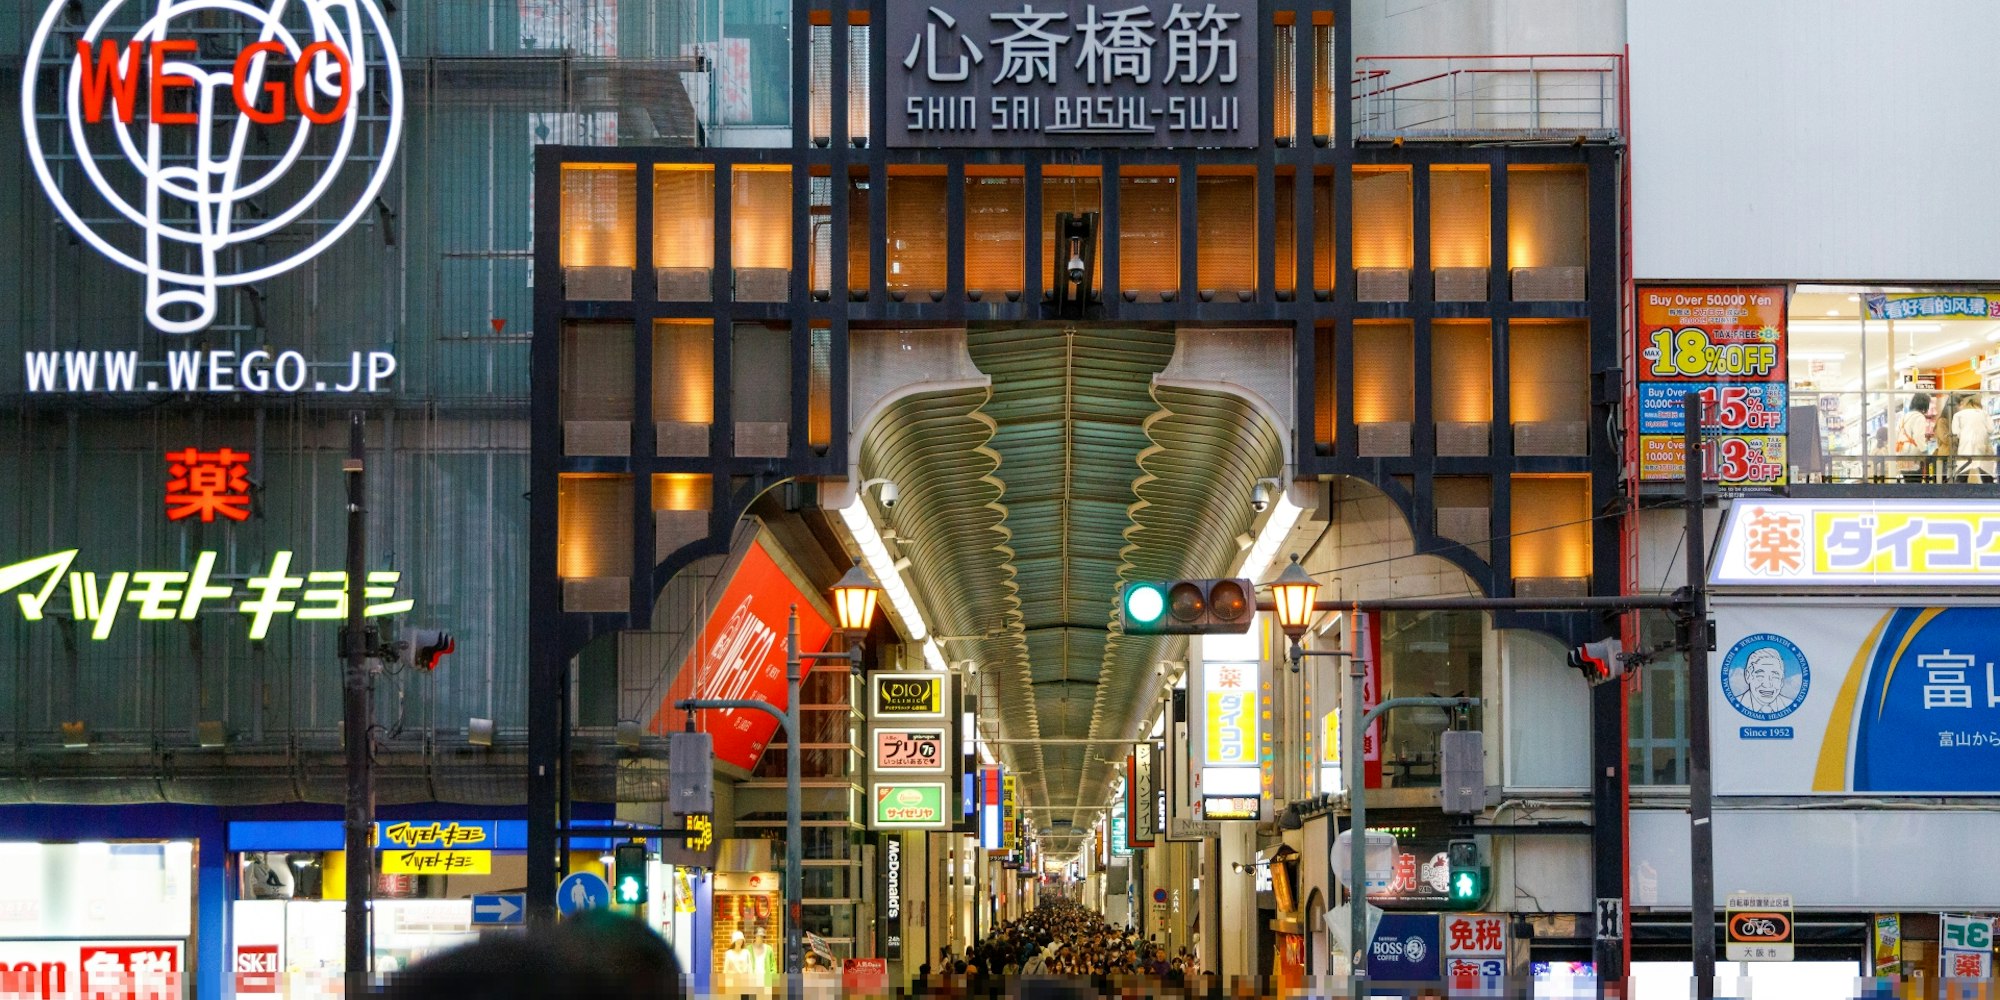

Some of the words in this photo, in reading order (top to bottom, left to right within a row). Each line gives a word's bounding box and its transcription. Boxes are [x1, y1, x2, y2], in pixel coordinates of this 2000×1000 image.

[903, 4, 1240, 84] 心斎橋筋
[907, 97, 976, 131] SHIN
[991, 97, 1040, 131] SAI
[1650, 295, 1672, 307] Buy
[1676, 295, 1703, 306] Over
[1706, 295, 1746, 307] 50,000
[1749, 295, 1772, 306] Yen
[1886, 296, 1986, 319] 看好看的风景
[25, 350, 397, 393] WWW.WEGO.JP
[1648, 388, 1664, 398] Buy
[1699, 387, 1747, 429] 15
[1748, 413, 1781, 428] OFF
[1649, 441, 1665, 451] Buy
[1645, 452, 1673, 461] 10,000
[1749, 465, 1782, 481] OFF
[165, 447, 250, 523] 薬
[1748, 507, 1801, 572] 薬
[1917, 649, 2000, 710] 富
[891, 683, 922, 697] DIO
[1220, 694, 1242, 759] ダイコク
[1744, 728, 1767, 737] Since
[1769, 728, 1790, 737] 1952
[884, 740, 918, 758] プリ
[922, 745, 934, 756] 7F
[887, 808, 934, 818] サイゼリヤ
[389, 823, 485, 846] マツモトキヨシ
[401, 852, 474, 871] マツモトキヨシ
[888, 839, 900, 919] McDonald's
[1449, 919, 1503, 951] 免税
[1373, 941, 1403, 954] BOSS
[1376, 954, 1399, 962] COFFEE
